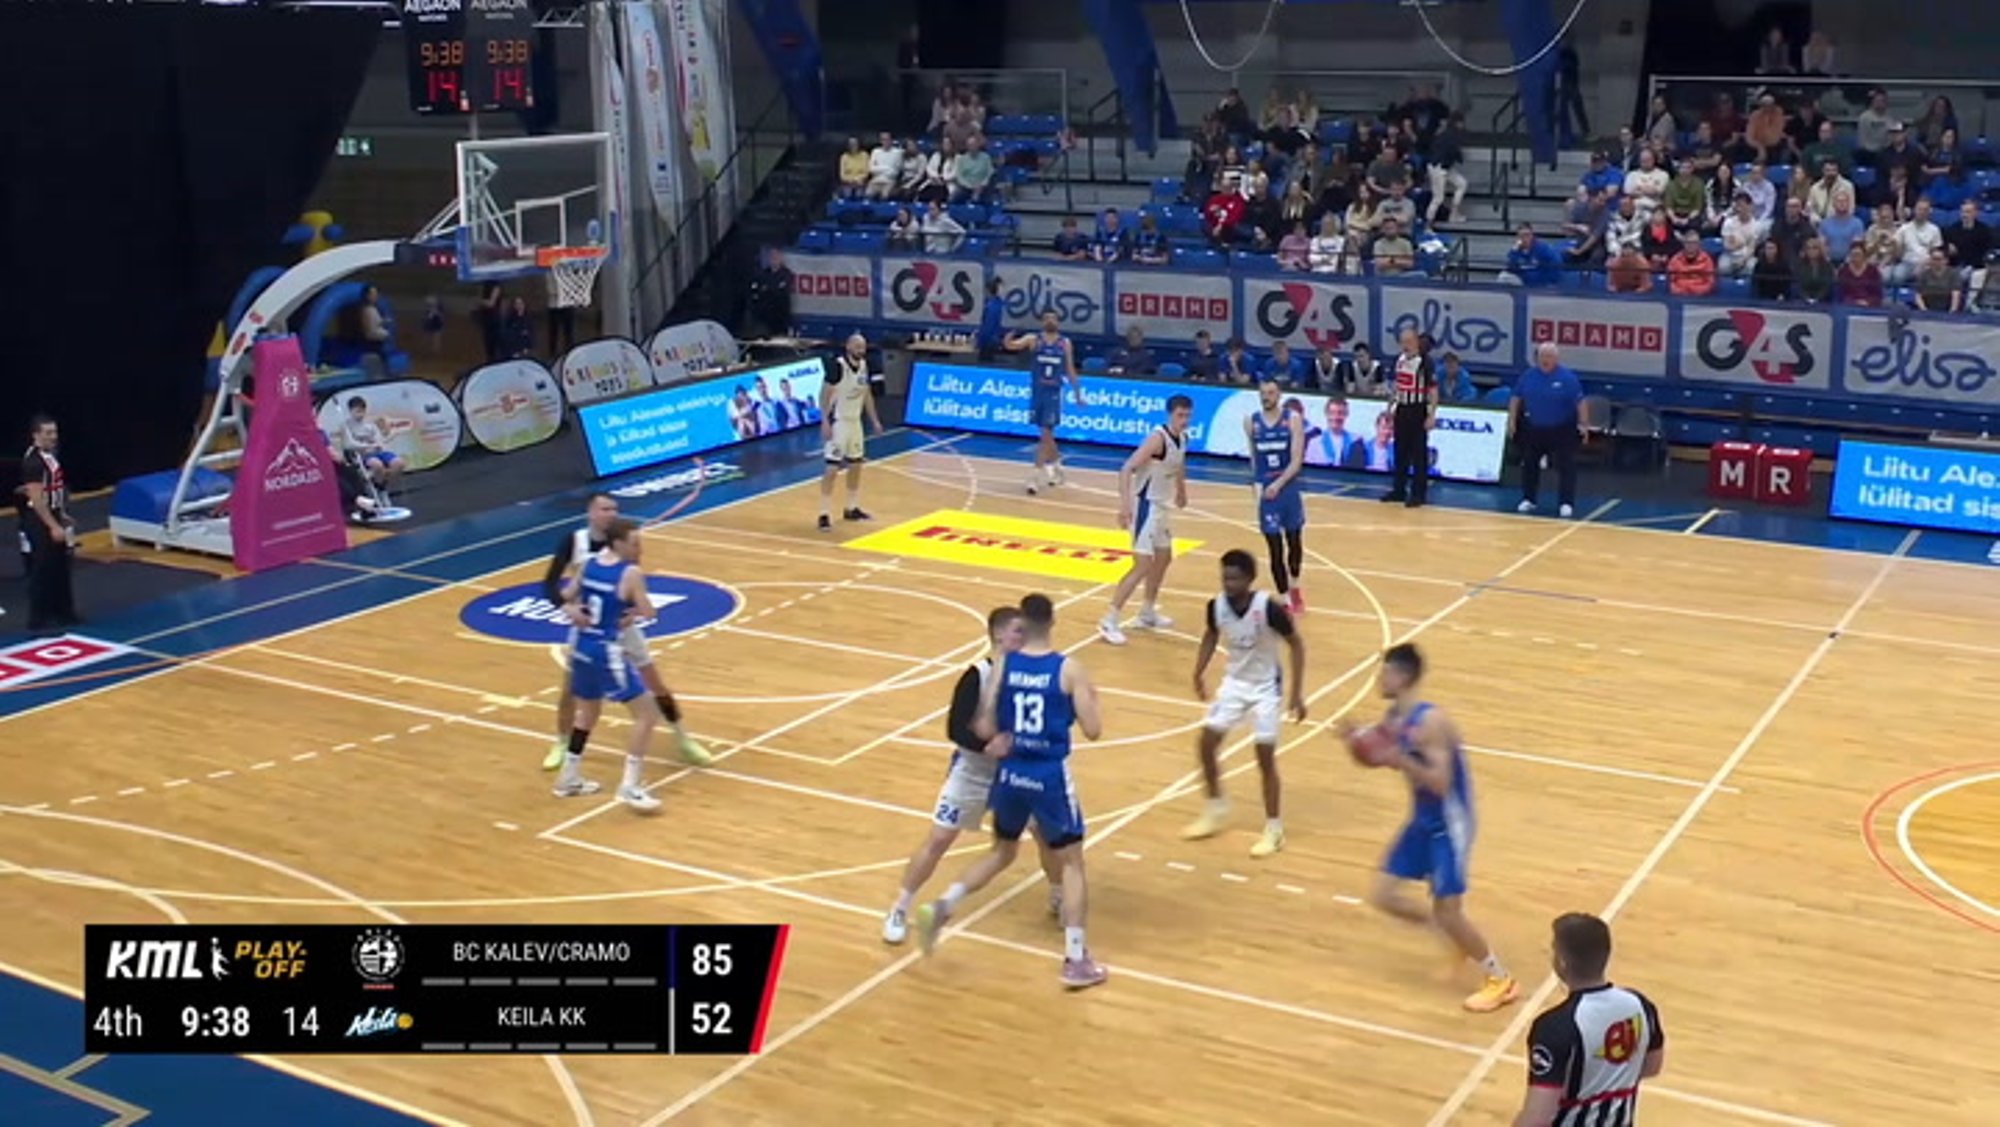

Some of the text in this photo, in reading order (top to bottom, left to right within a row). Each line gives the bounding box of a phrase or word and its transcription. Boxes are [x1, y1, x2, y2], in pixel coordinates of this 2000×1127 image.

[421, 41, 463, 66] 9:38
[487, 40, 528, 63] 9:38
[428, 71, 458, 102] 14
[494, 69, 523, 101] 14
[791, 273, 870, 298] RAMO
[892, 262, 976, 322] G4S
[1004, 273, 1101, 324] elisa
[1257, 282, 1356, 350] G4S
[1385, 298, 1508, 352] elisa
[1531, 318, 1662, 352] CRAMO
[1696, 309, 1815, 384] G4S
[1851, 329, 1997, 392] elisa
[927, 374, 972, 394] Liitu
[1719, 460, 1791, 495] M R
[1863, 456, 2000, 490] Liitu Ale
[1012, 692, 1045, 734] 13
[936, 804, 960, 824] 24
